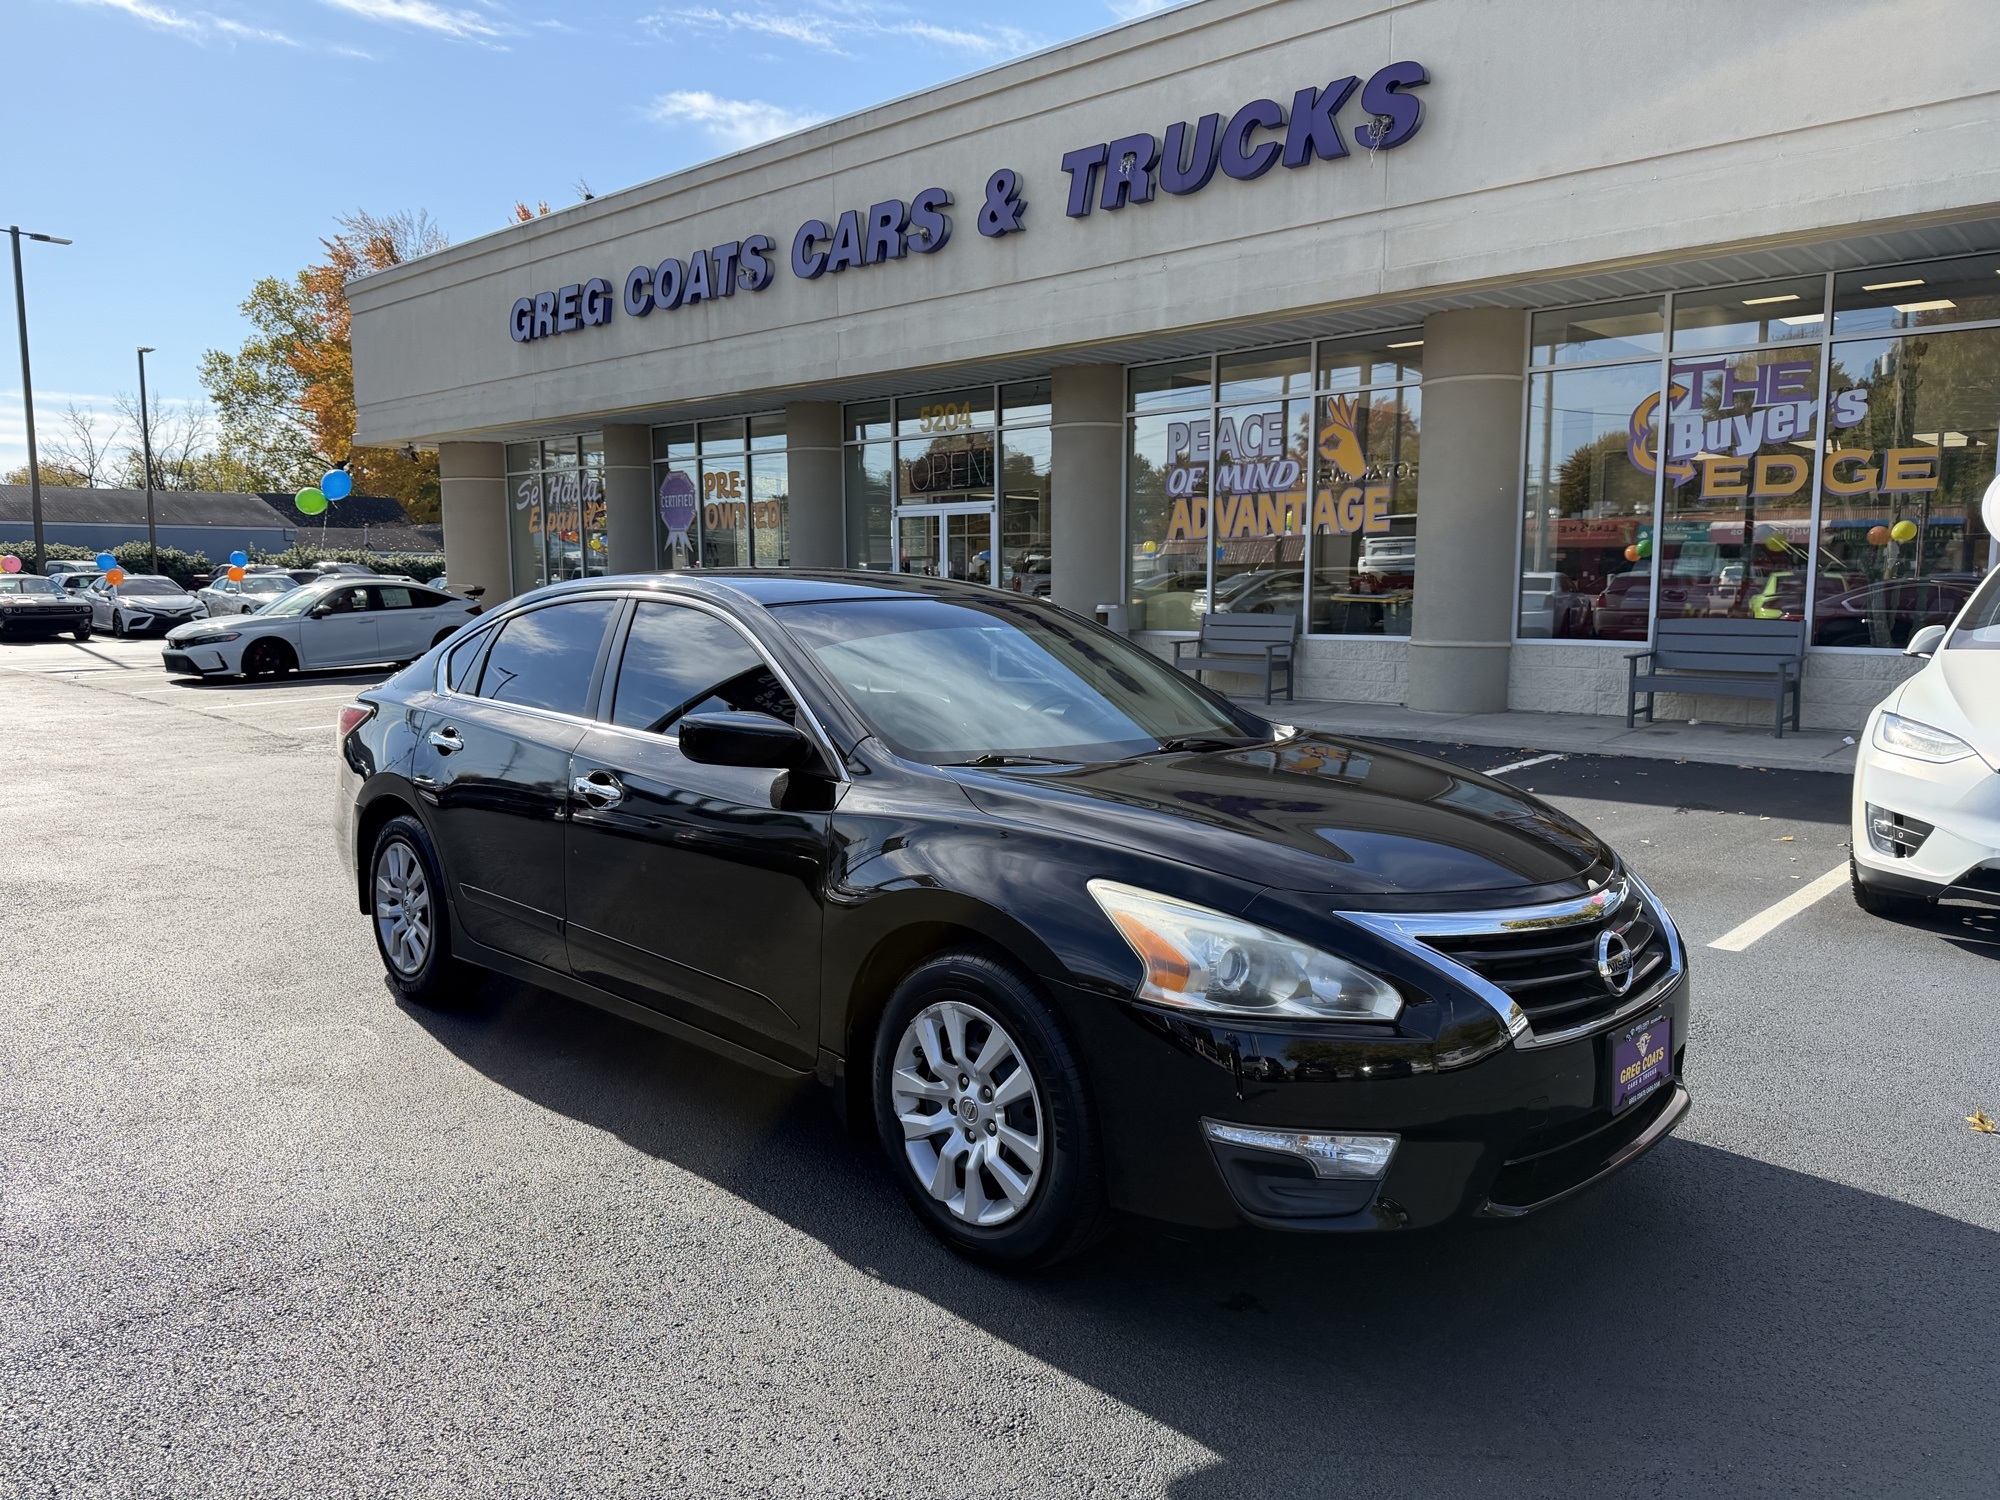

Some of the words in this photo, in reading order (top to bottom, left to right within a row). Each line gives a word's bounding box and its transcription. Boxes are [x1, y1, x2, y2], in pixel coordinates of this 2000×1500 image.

[510, 277, 613, 343] GREG
[624, 234, 776, 317] COATS
[791, 187, 955, 280] CARS
[977, 168, 1028, 239] &
[1061, 60, 1430, 219] TRUCKS
[1671, 358, 1813, 412] THE
[919, 401, 972, 432] 5204
[1672, 387, 1869, 460] Buyer's
[1167, 411, 1283, 466] PEACE
[704, 471, 745, 499] PRE-
[910, 450, 987, 491] OPEN
[1166, 467, 1206, 497] OF
[1215, 460, 1300, 494] MIND
[1699, 447, 1940, 500] EDGE
[516, 480, 539, 510] Se
[547, 473, 602, 504] Habla
[660, 493, 694, 508] CERTIFIED
[705, 501, 780, 530] OWNED
[1167, 485, 1391, 540] ADVANTAGE
[1620, 1061, 1641, 1084] GREG
[1642, 1046, 1664, 1070] COATS
[1627, 1080, 1638, 1091] CARS
